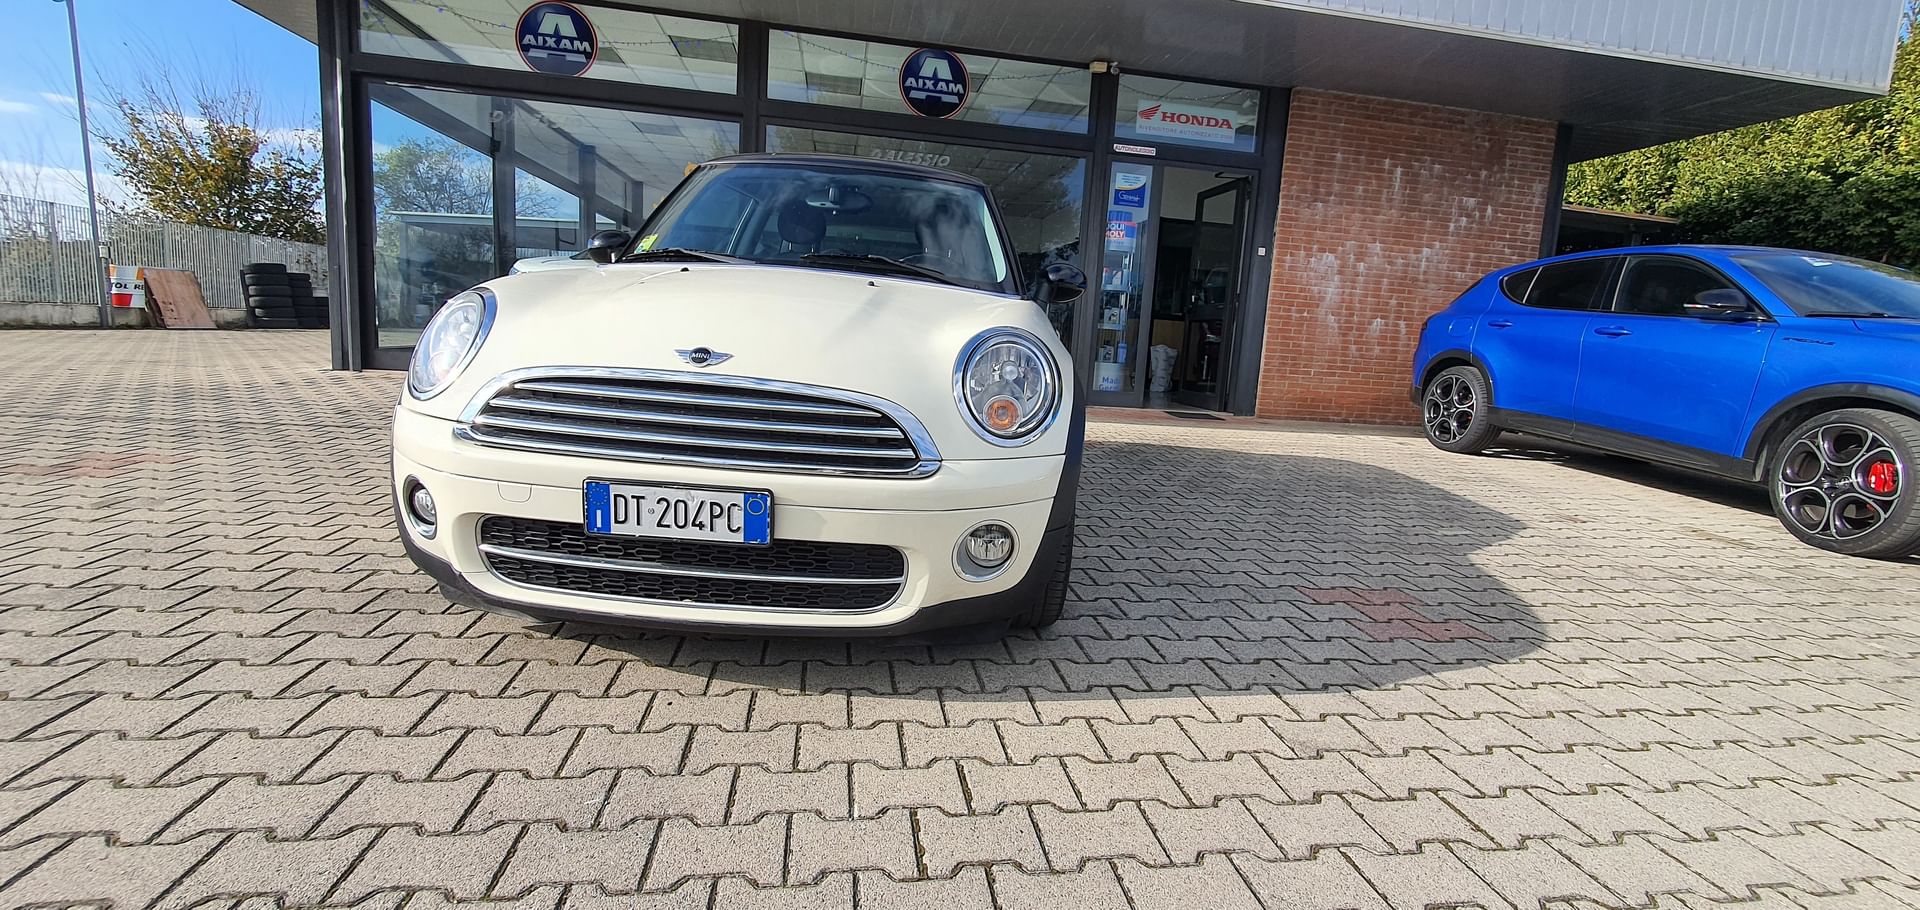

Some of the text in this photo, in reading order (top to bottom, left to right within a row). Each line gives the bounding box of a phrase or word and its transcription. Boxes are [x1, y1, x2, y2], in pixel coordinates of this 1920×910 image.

[521, 34, 592, 52] AIXAM
[904, 77, 965, 94] AIXAM
[1160, 111, 1234, 130] HONDA
[613, 493, 646, 527] DT
[656, 497, 743, 534] 204PC
